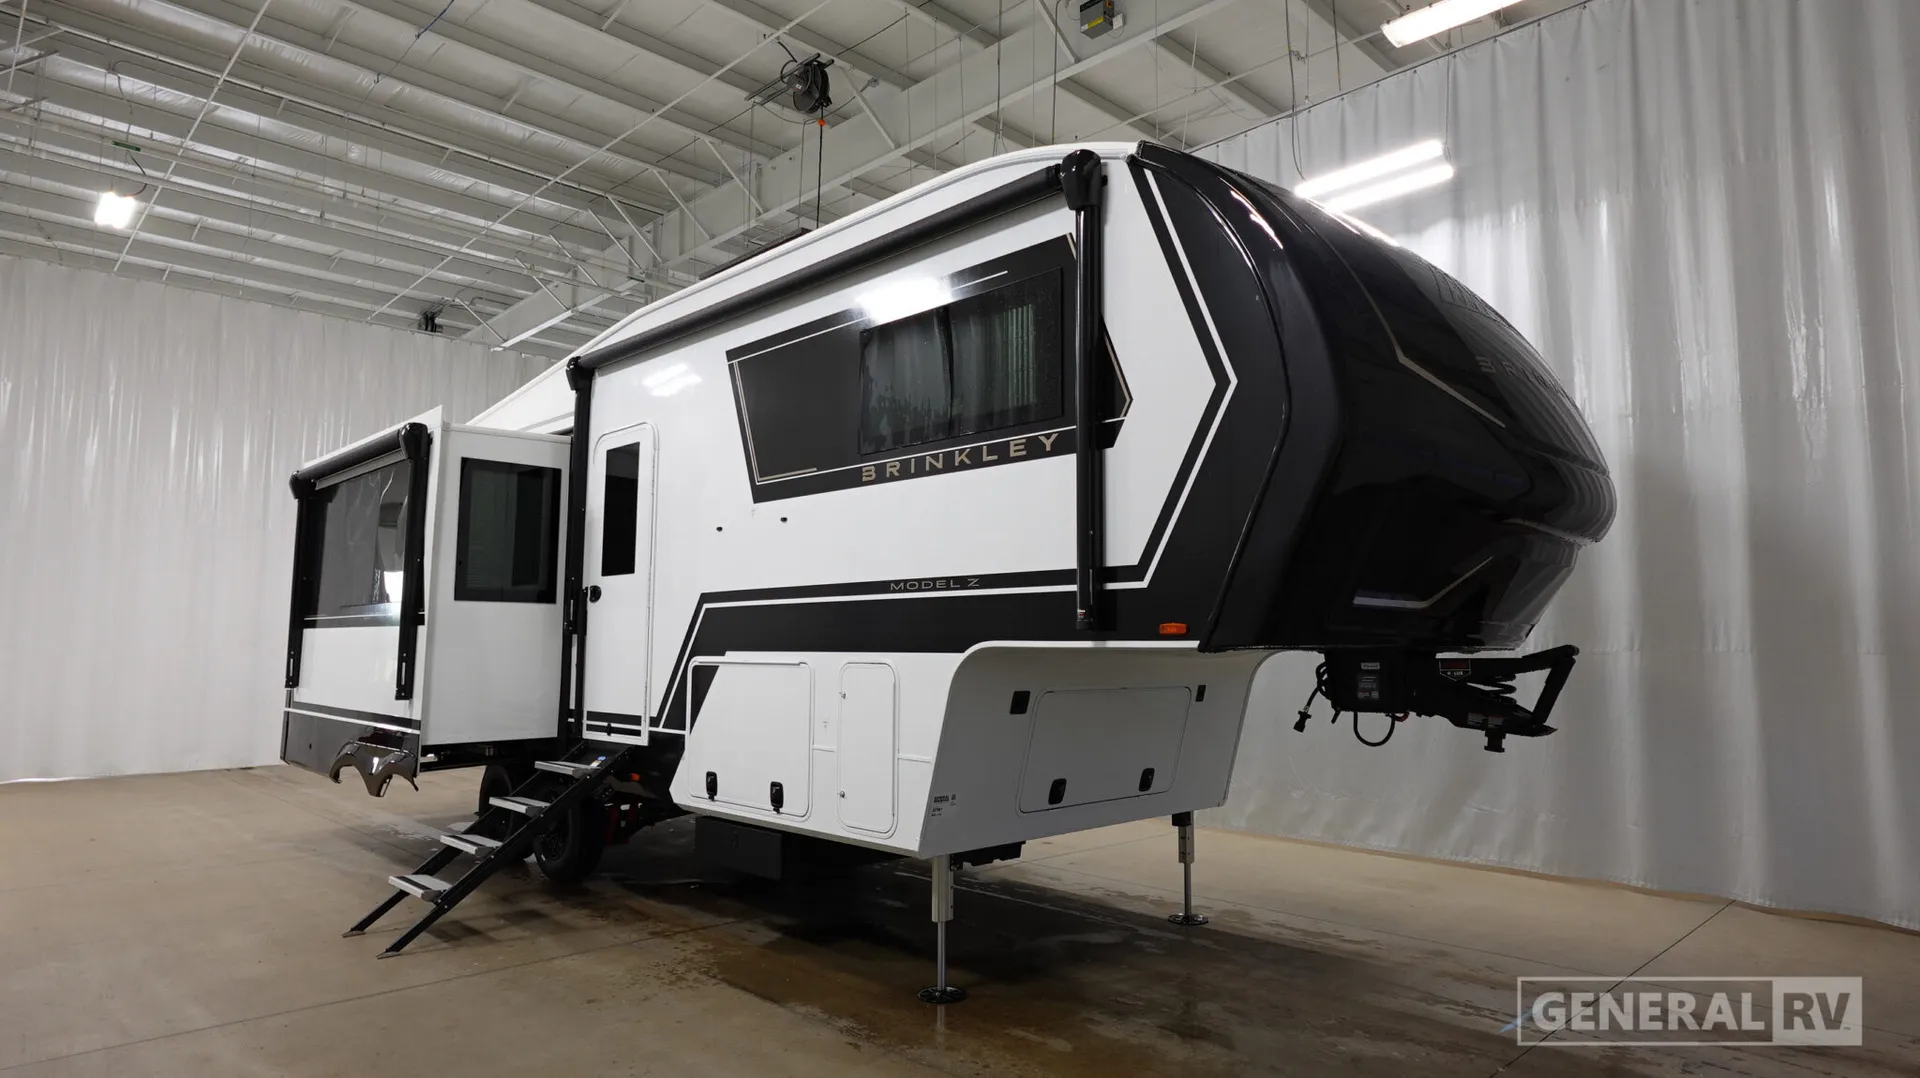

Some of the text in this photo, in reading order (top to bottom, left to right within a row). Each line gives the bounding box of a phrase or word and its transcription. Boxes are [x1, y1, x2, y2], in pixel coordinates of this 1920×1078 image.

[862, 433, 1060, 482] BRINKLEY
[890, 578, 980, 591] MODEL Z
